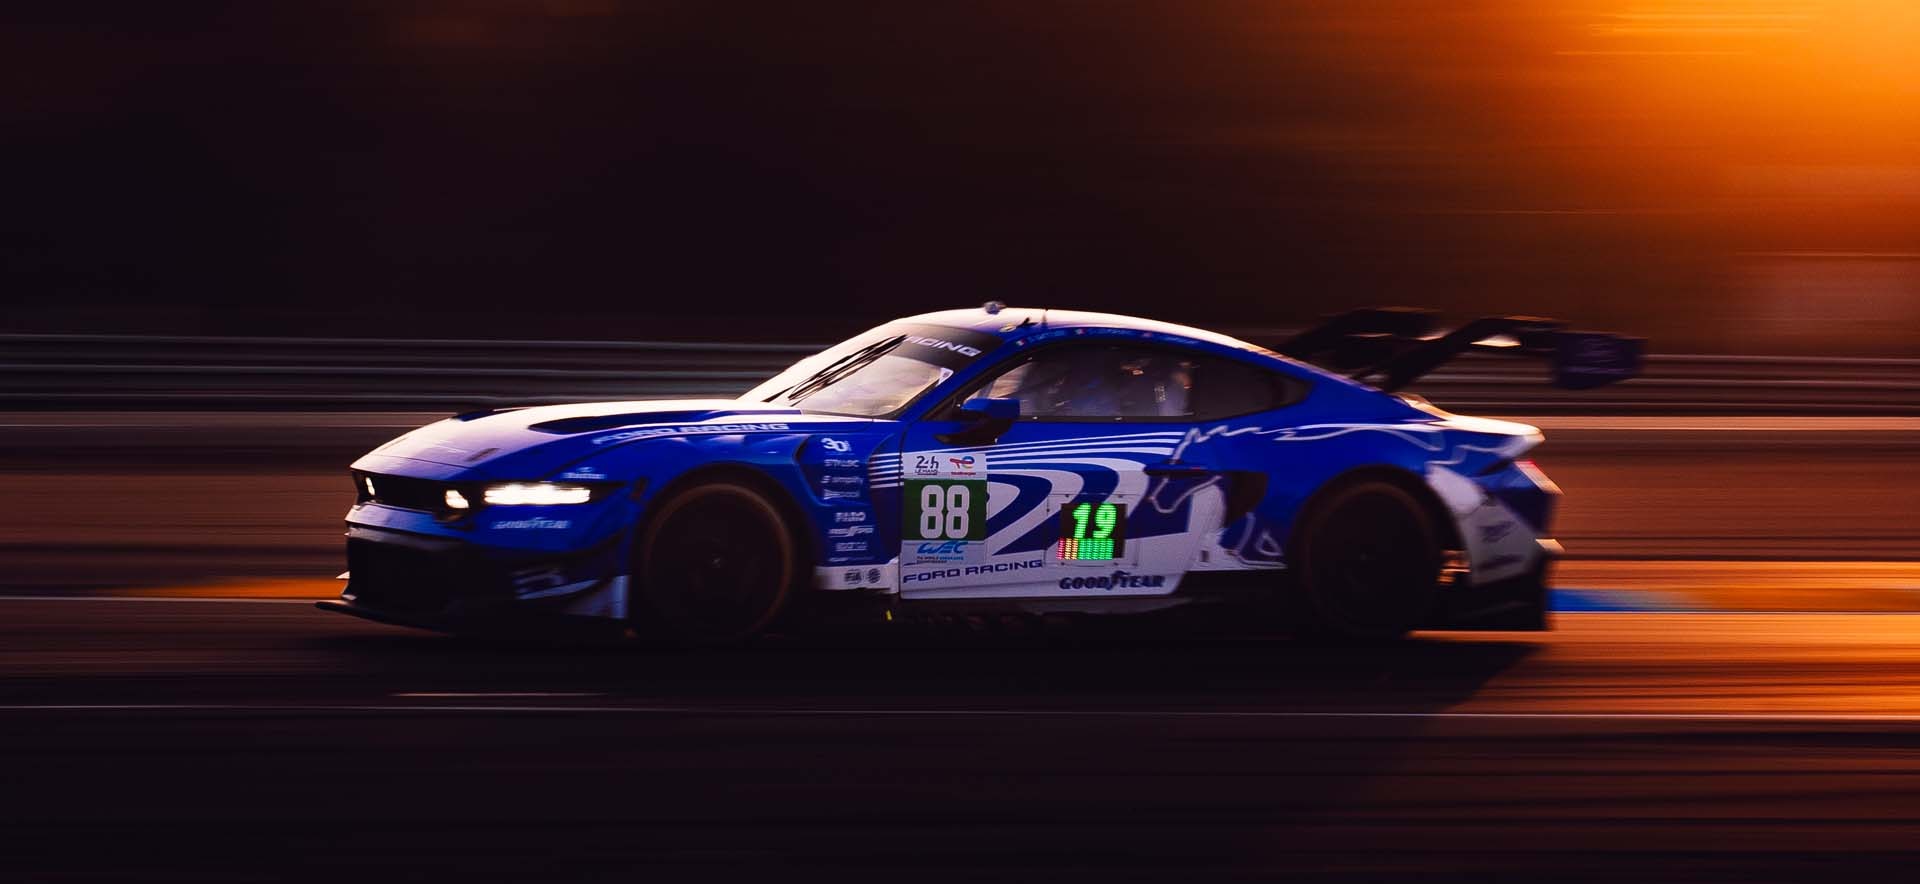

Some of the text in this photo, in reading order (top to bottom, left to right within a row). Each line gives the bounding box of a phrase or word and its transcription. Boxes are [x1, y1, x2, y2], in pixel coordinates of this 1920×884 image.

[592, 423, 789, 444] FORD RACING
[920, 484, 970, 539] 88
[1072, 503, 1117, 539] 19
[916, 540, 968, 554] WEC
[903, 559, 1043, 583] FORD RACING
[1060, 570, 1165, 590] GOODYEAR
